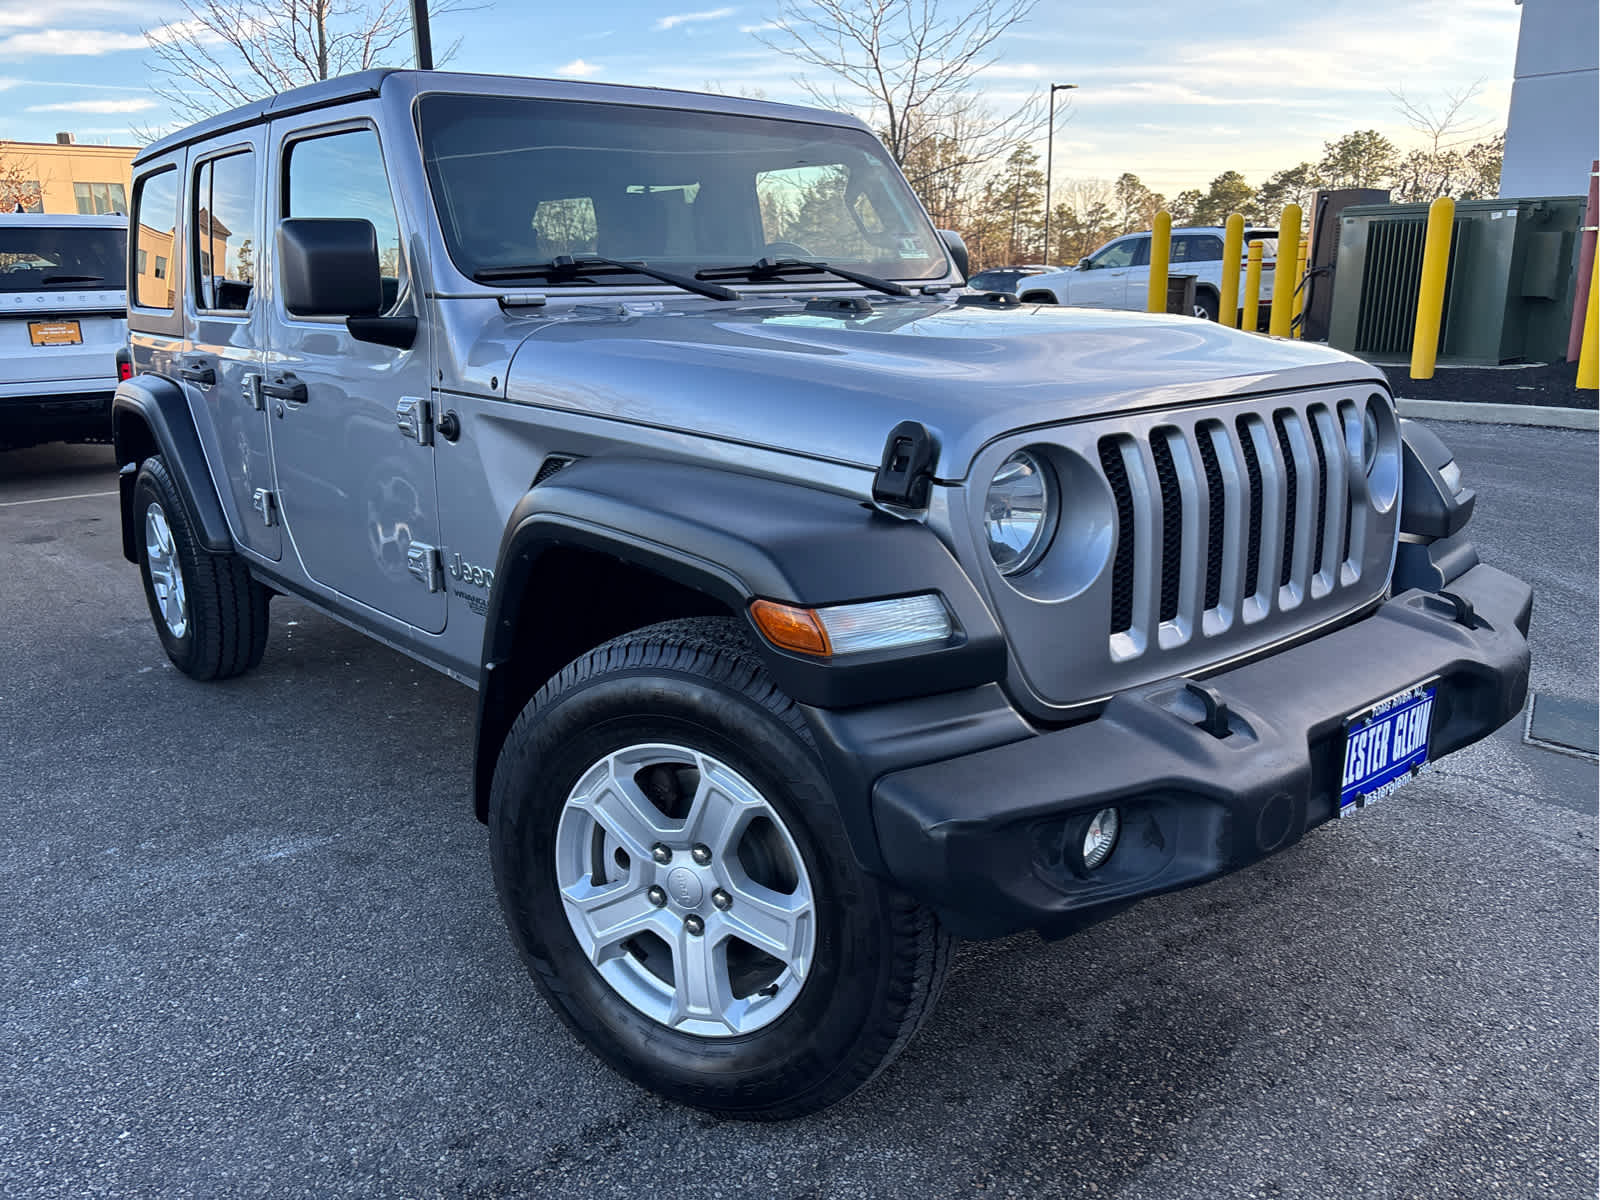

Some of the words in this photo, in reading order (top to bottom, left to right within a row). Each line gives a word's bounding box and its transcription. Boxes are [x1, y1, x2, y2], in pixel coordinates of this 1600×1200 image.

[449, 553, 495, 587] Jeep
[1342, 720, 1391, 788] LESTER
[1392, 700, 1432, 762] GLENN
